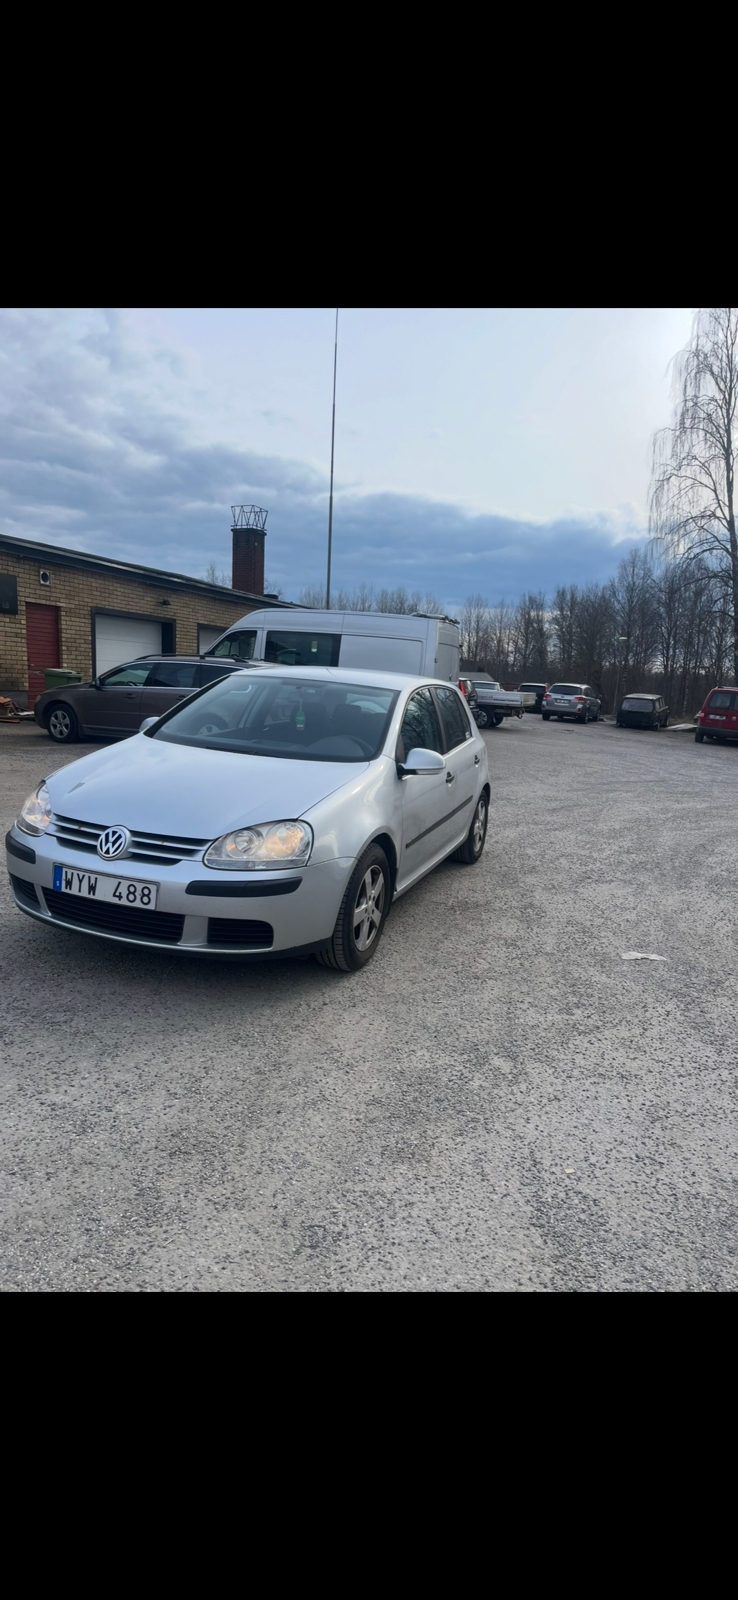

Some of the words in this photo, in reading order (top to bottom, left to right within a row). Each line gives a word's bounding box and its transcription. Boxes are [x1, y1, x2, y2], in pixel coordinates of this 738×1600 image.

[99, 829, 126, 857] VW
[64, 870, 98, 896] WYW
[112, 881, 152, 906] 488
